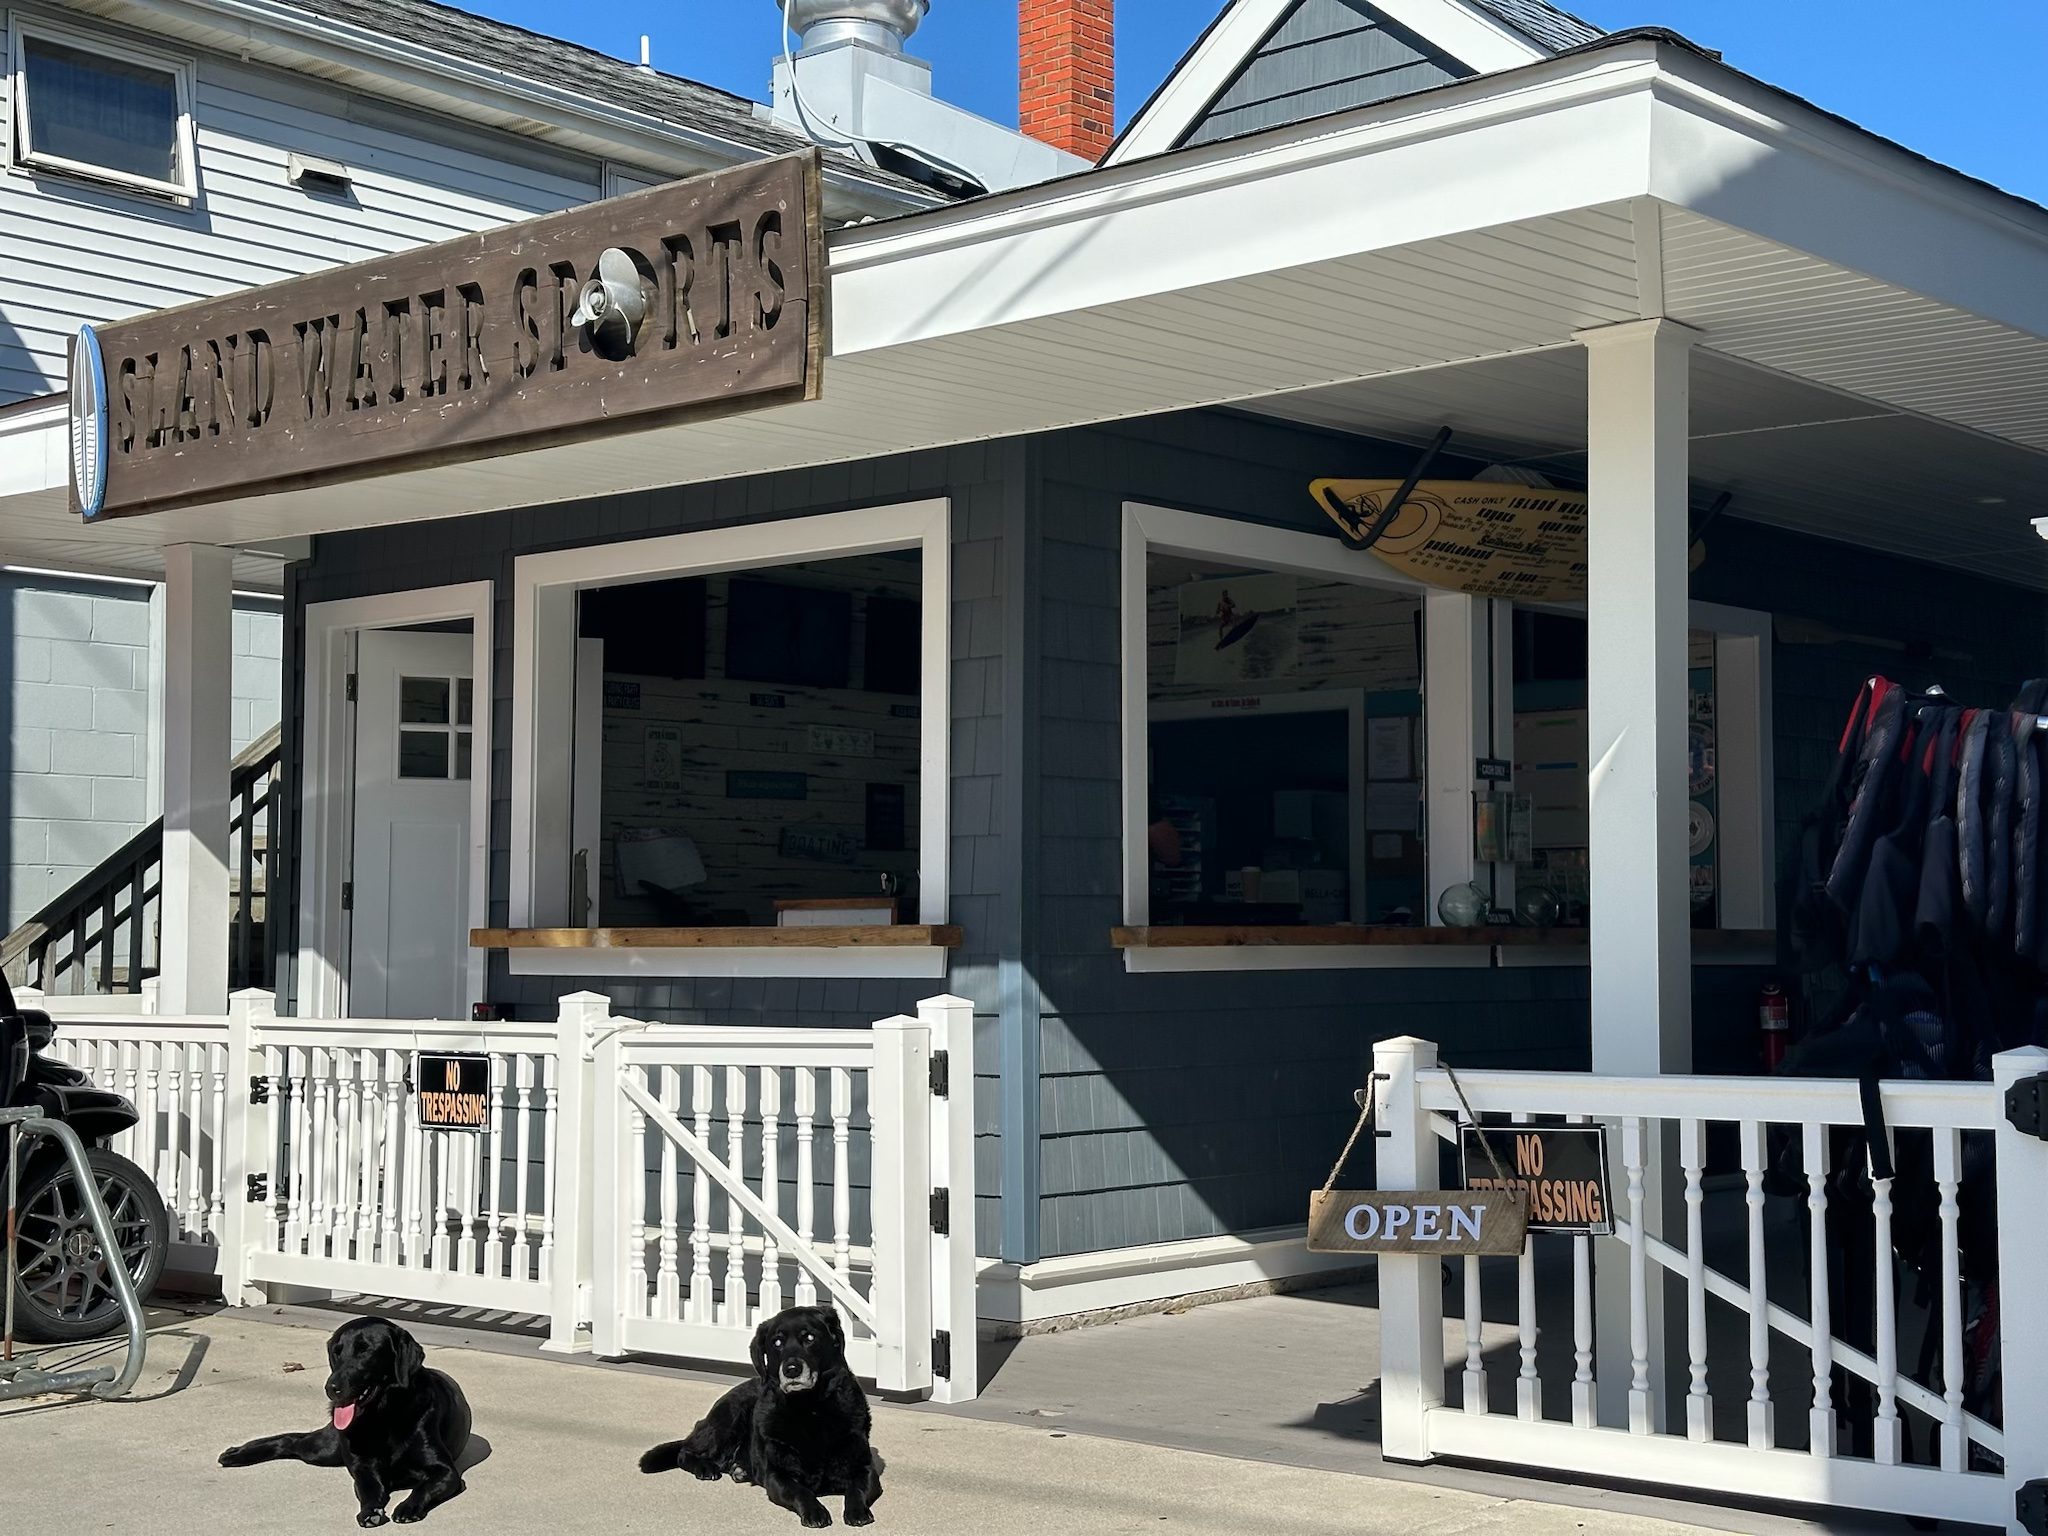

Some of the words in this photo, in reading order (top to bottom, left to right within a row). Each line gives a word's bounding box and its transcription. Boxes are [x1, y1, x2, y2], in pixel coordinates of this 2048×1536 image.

[293, 283, 490, 421] WATER
[512, 210, 785, 378] SPORTS
[1454, 497, 1479, 505] CASH
[1481, 497, 1506, 505] ONLY
[446, 1060, 460, 1091] NO
[421, 1092, 487, 1124] TRESPASSING
[1516, 1134, 1543, 1176] NO
[1469, 1178, 1601, 1222] ASSING
[1345, 1204, 1486, 1241] OPEN
